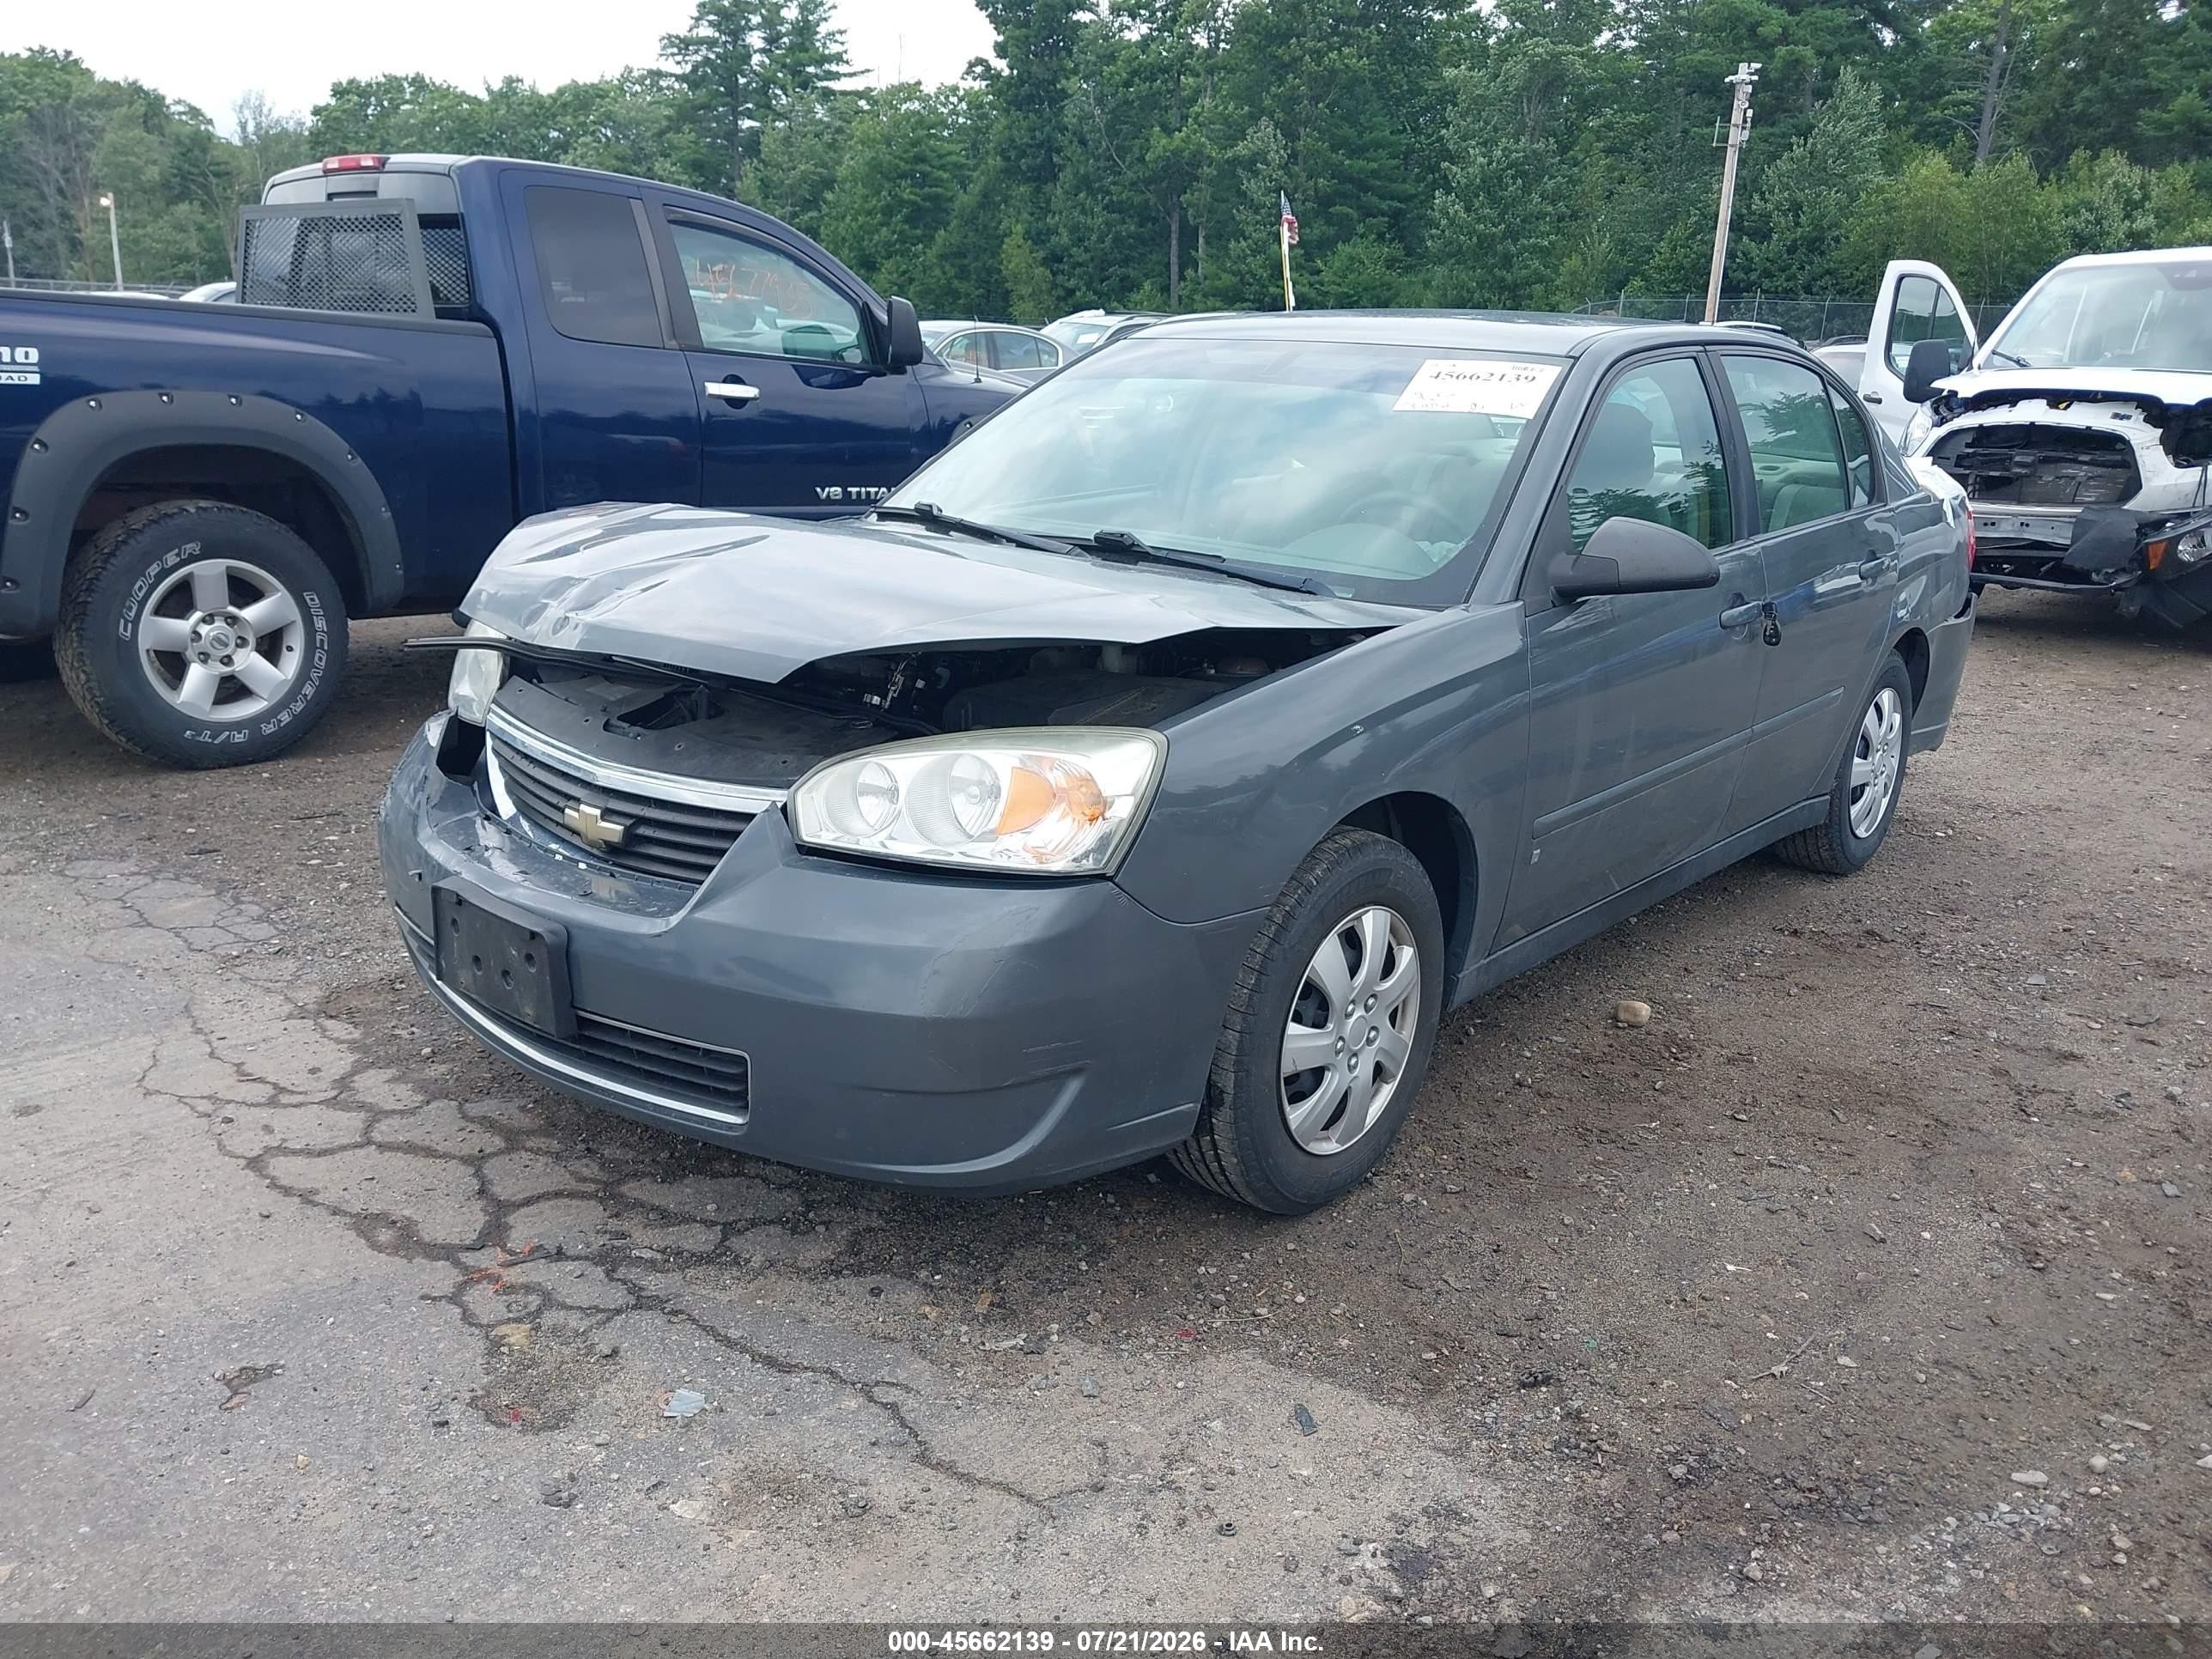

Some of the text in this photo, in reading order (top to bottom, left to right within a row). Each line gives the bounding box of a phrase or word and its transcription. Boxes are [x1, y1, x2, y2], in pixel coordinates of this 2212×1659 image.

[814, 486, 896, 500] V8 TITA
[118, 542, 201, 641] COOPER
[260, 591, 328, 735] DISCOVERER
